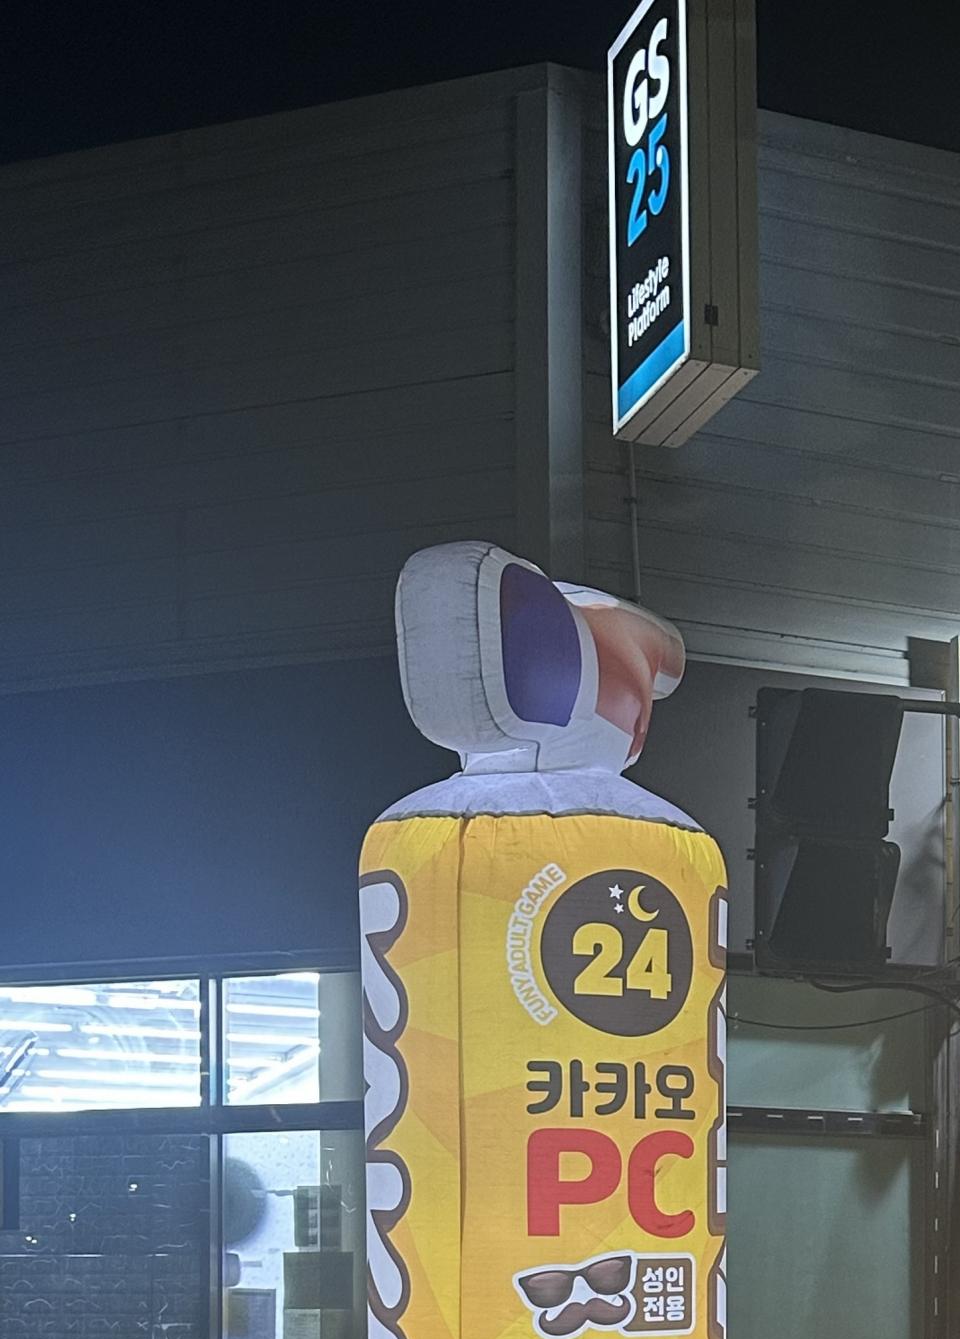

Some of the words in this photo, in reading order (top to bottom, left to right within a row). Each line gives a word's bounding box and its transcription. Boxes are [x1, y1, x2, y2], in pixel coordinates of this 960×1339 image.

[624, 18, 669, 146] GS
[627, 113, 670, 247] 25
[628, 256, 669, 317] Lifestyle
[628, 285, 670, 347] Platform
[518, 865, 563, 918] GAME
[510, 915, 530, 973] ADULT
[572, 922, 672, 1000] 24
[513, 974, 555, 1023] FUNY
[527, 1059, 696, 1120] 카카오
[527, 1128, 696, 1239] PC
[642, 1265, 685, 1294] 성인
[642, 1295, 685, 1324] 전용
